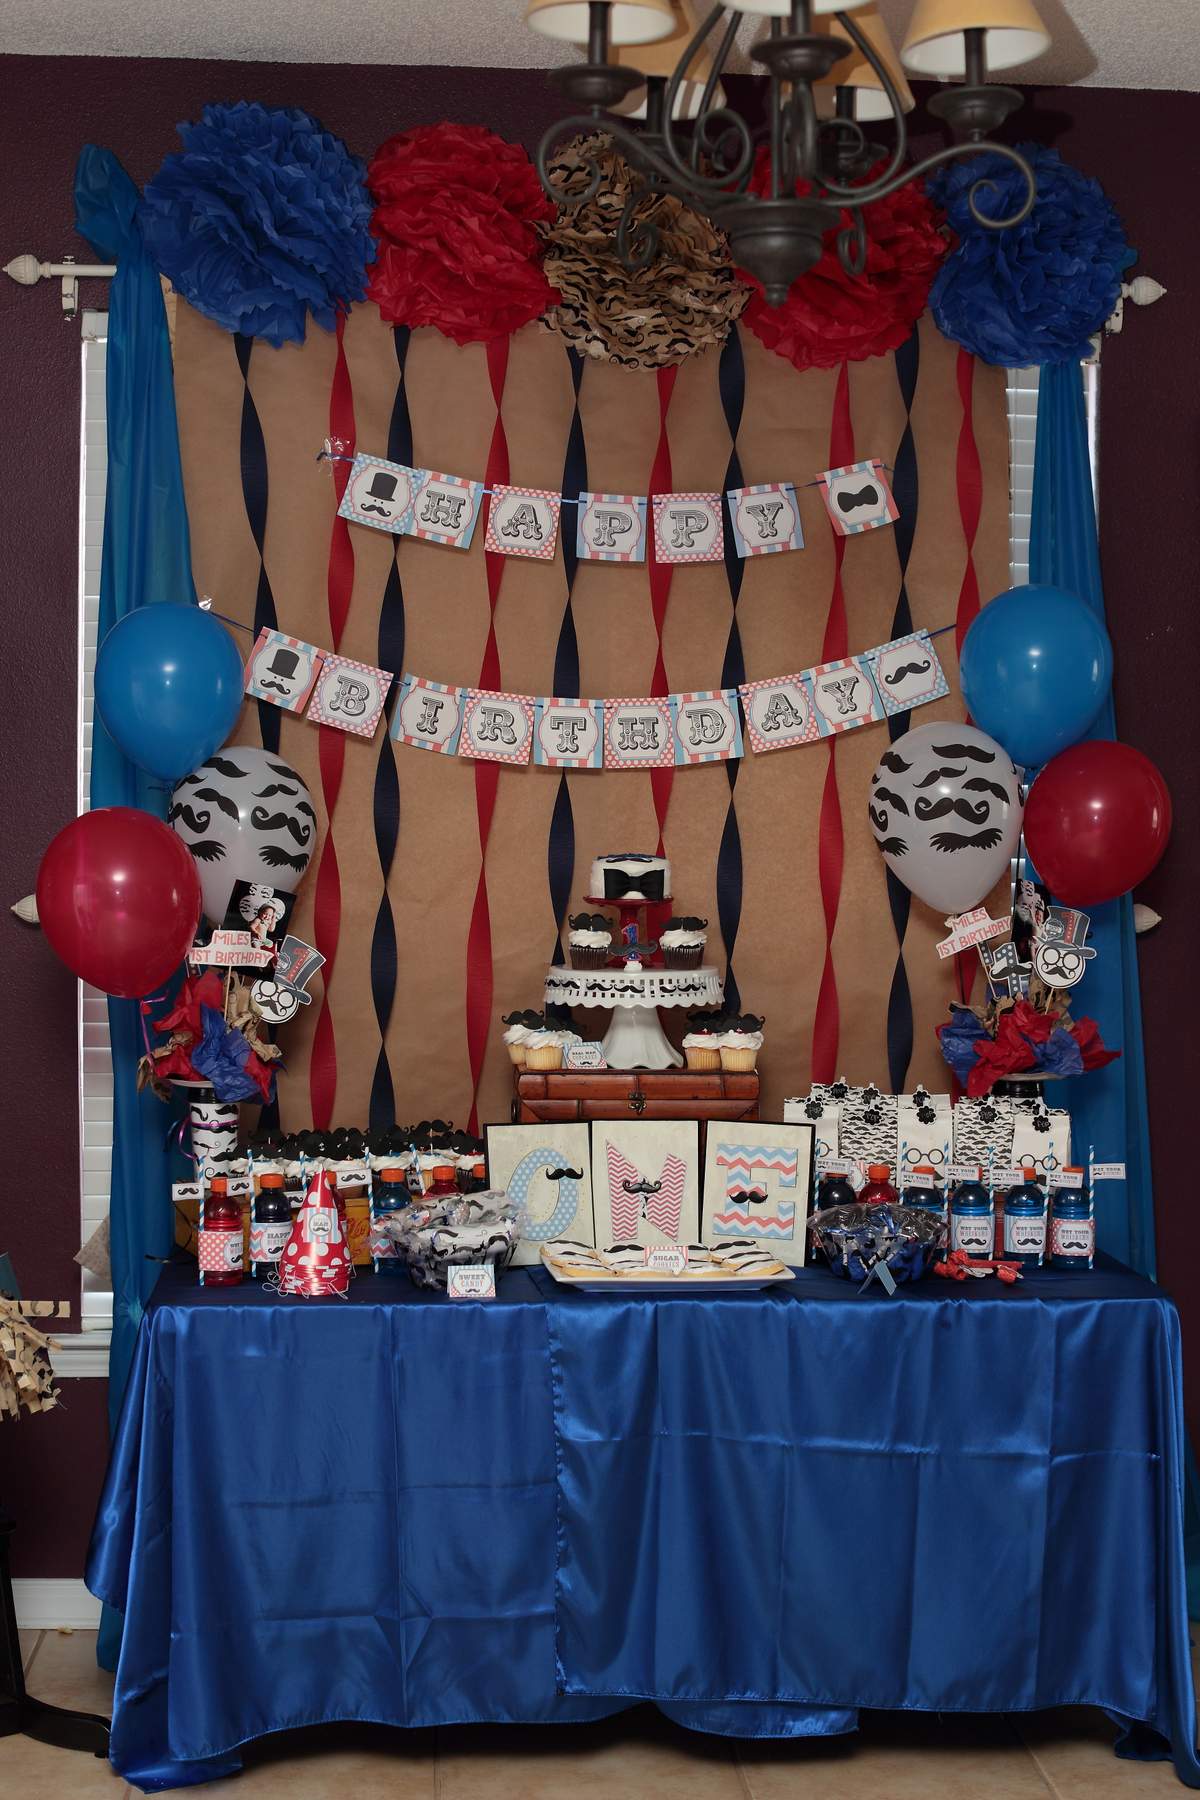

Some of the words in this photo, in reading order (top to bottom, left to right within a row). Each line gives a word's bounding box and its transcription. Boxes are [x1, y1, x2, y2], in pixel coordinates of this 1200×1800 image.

[421, 489, 784, 548] HAPPY
[329, 674, 860, 754] BIRTHDAY
[953, 909, 988, 930] MILES
[190, 949, 210, 963] 1ST
[215, 950, 270, 965] BIRTHDAY
[214, 931, 250, 946] MILES
[938, 943, 956, 957] 1ST
[958, 920, 1011, 949] BIRTHDAY
[507, 1140, 799, 1242] ONE
